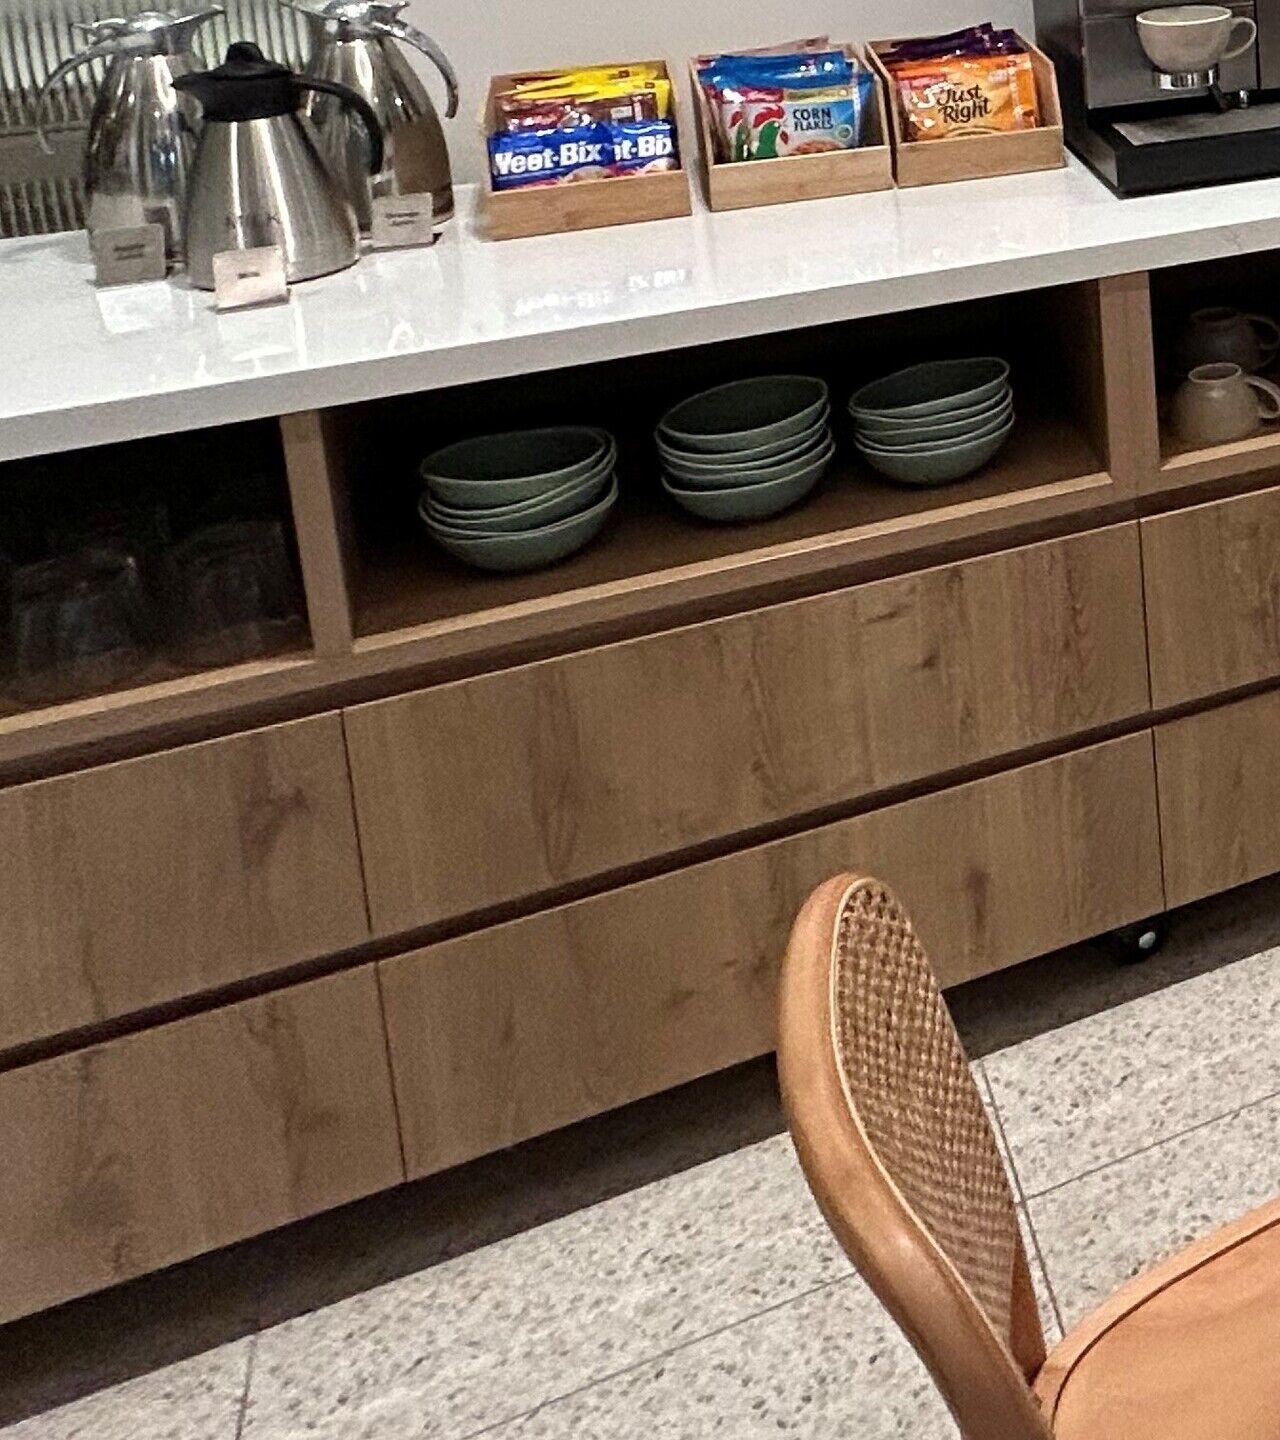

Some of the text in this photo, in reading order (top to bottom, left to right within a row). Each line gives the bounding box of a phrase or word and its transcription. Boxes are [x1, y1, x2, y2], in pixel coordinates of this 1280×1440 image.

[937, 83, 983, 107] Just
[793, 108, 831, 120] CORN
[938, 101, 992, 123] Right
